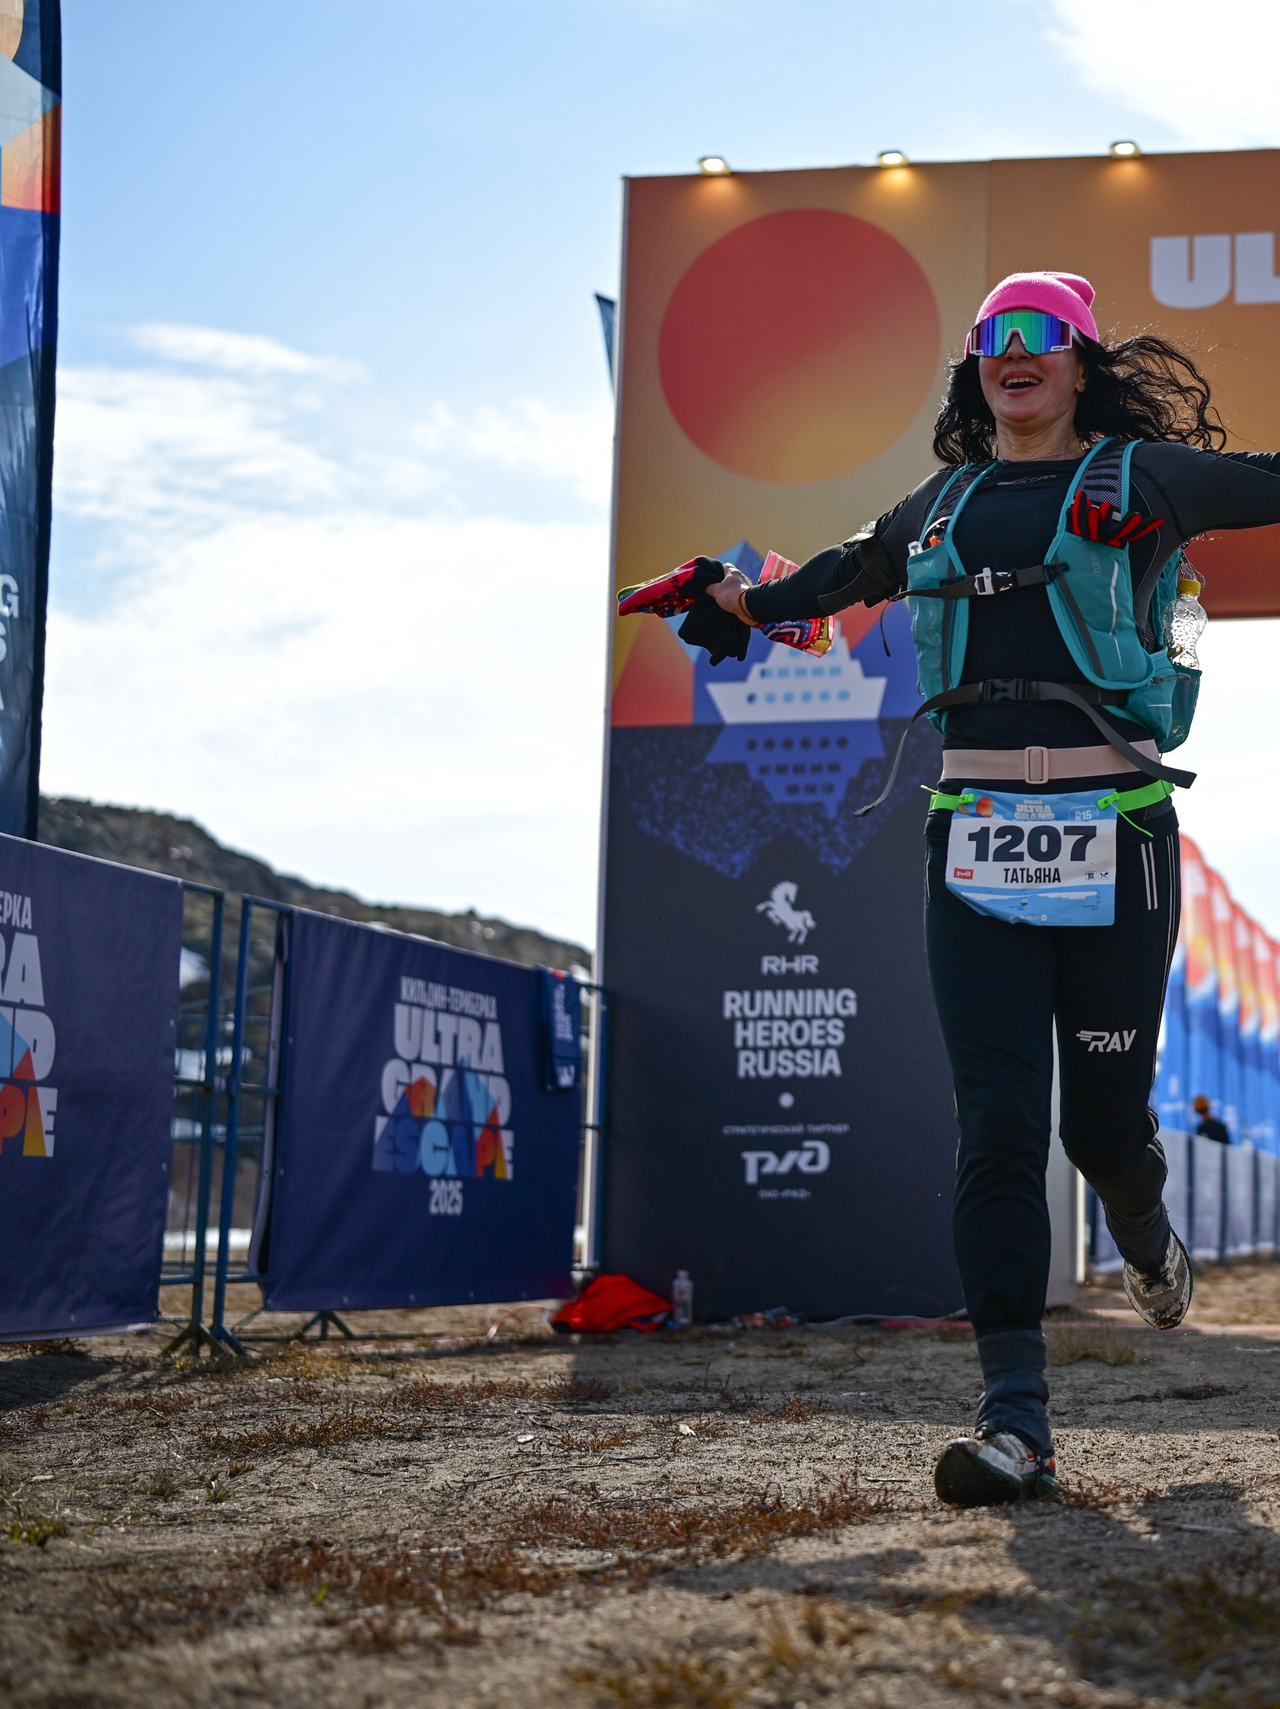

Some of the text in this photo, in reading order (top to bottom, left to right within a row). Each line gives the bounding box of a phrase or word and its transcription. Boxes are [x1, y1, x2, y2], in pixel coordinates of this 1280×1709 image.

[1015, 804, 1052, 813] ULTRA
[967, 825, 1097, 862] 1207
[1003, 867, 1062, 883] ТАТЬЯНА
[761, 954, 819, 974] RHR
[723, 988, 857, 1019] RUNNING
[394, 1002, 505, 1074] ULTRA
[734, 1018, 845, 1048] HEROES
[1076, 1029, 1137, 1052] RAY
[737, 1048, 842, 1078] RUSSIA
[381, 1058, 512, 1127] GRAND
[372, 1115, 515, 1181] ESCAPE
[429, 1179, 463, 1216] 2025
